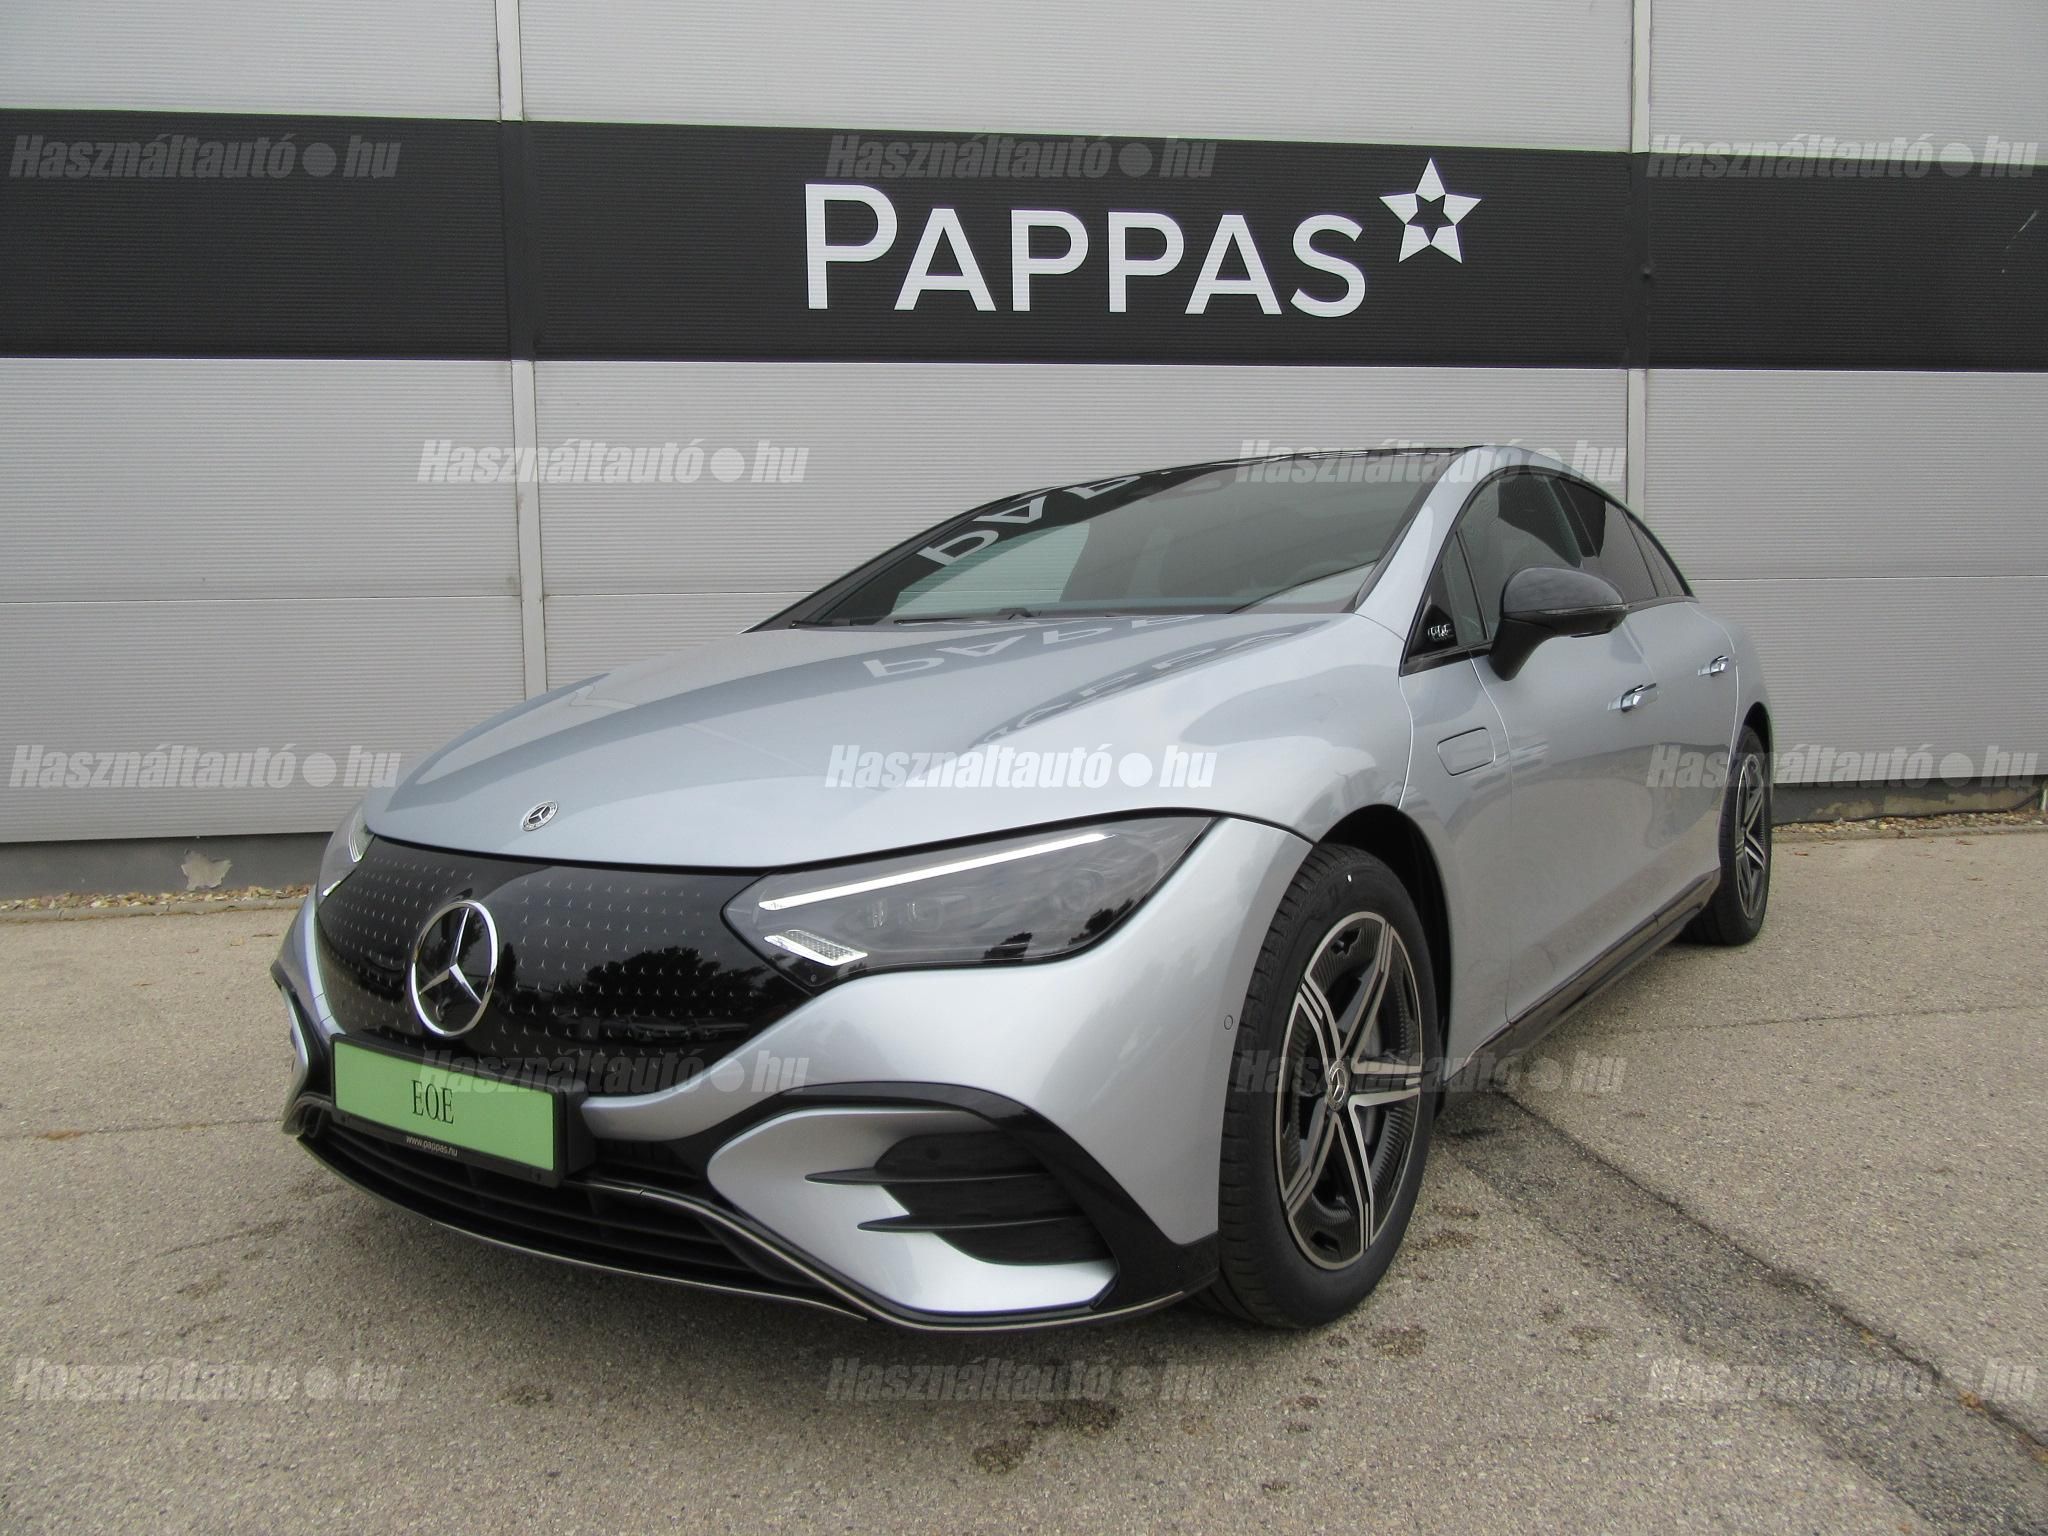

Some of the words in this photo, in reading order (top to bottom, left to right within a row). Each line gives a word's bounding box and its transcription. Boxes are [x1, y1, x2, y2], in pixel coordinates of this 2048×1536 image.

[805, 183, 1367, 318] PAPPAS
[411, 1080, 455, 1124] EQE
[406, 1136, 458, 1157] www.pappas.hu
